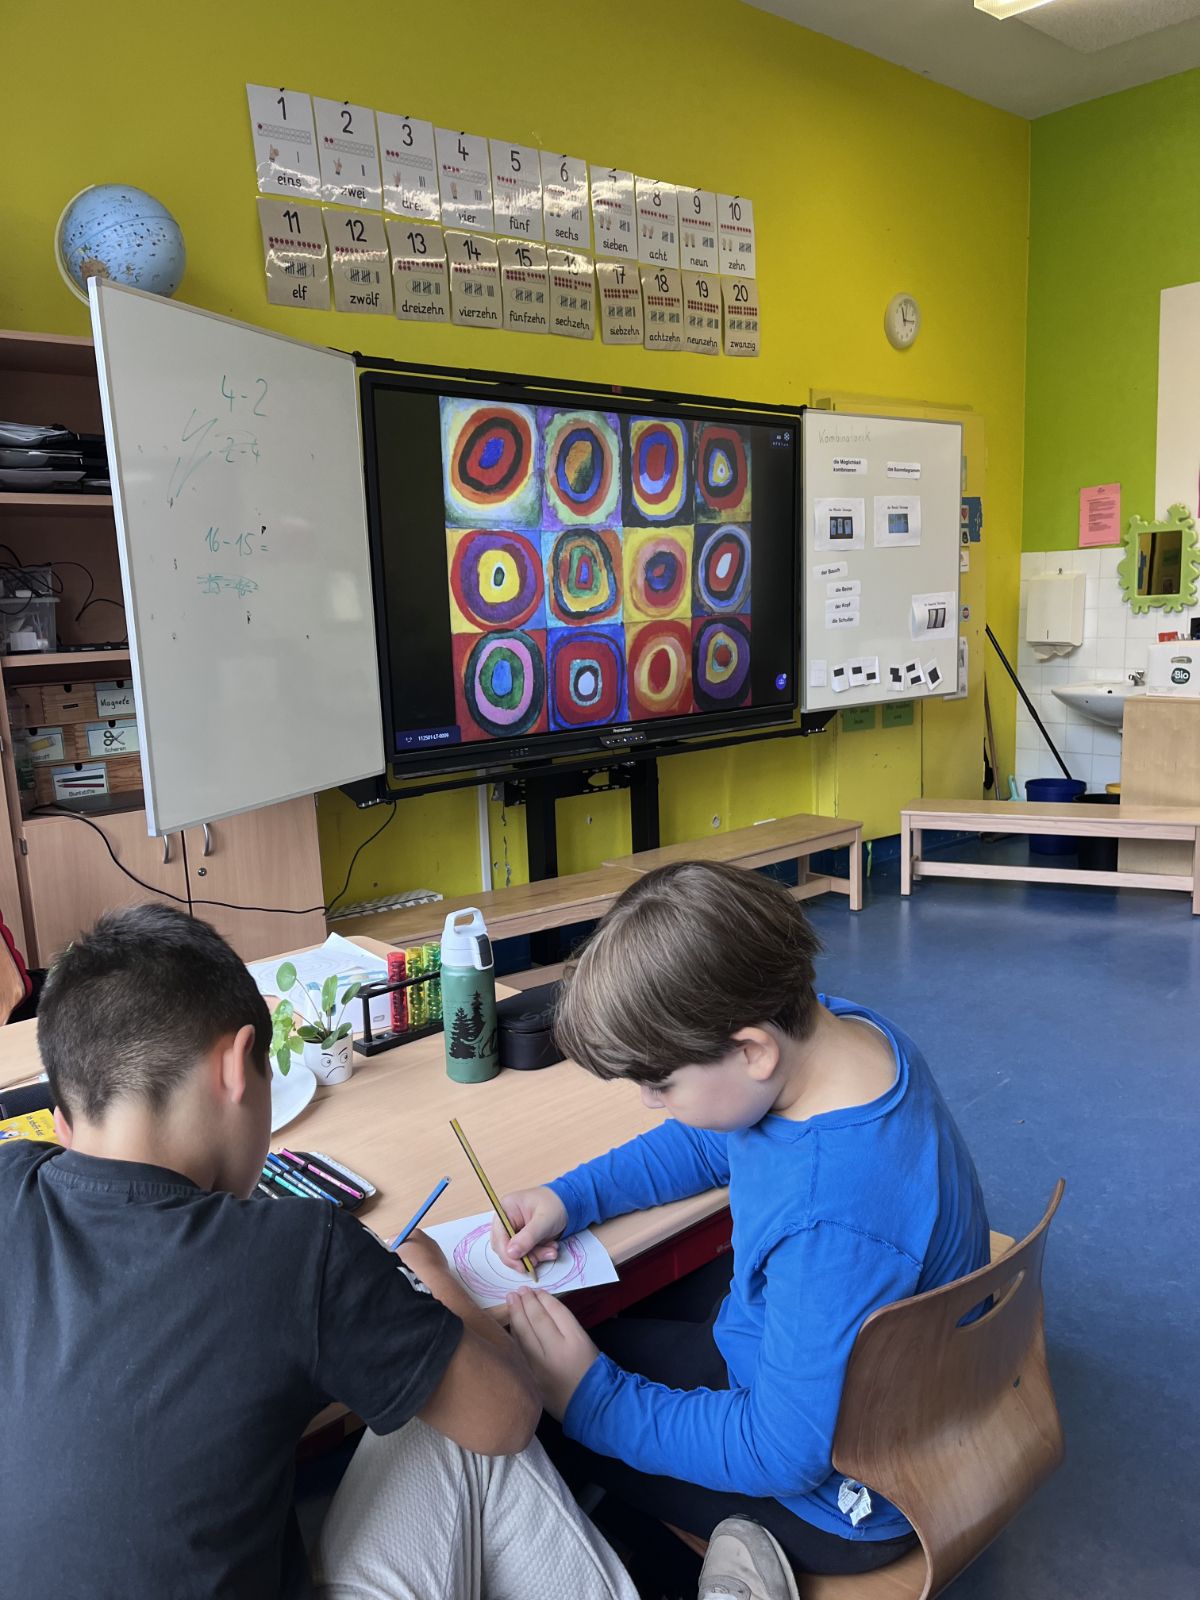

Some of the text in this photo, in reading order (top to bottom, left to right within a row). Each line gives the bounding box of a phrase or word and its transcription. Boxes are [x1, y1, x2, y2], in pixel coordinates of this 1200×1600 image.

[277, 97, 287, 121] 1
[340, 110, 354, 135] 2
[401, 124, 414, 147] 3
[458, 139, 469, 162] 4
[510, 150, 522, 172] 5
[277, 173, 302, 188] eins
[560, 162, 569, 183] 6
[340, 186, 367, 200] zwei
[402, 197, 424, 212] dre
[693, 195, 702, 215] 9
[728, 202, 742, 222] 10
[282, 210, 302, 234] 11
[458, 210, 477, 224] vier
[509, 216, 531, 233] fünf
[345, 219, 368, 242] 12
[555, 226, 579, 241] sechs
[407, 232, 427, 254] 13
[462, 240, 482, 261] 14
[602, 238, 629, 253] sieben
[515, 247, 533, 268] 15
[649, 250, 668, 262] acht
[690, 257, 709, 268] neun
[613, 265, 626, 284] 17
[728, 260, 746, 272] zehn
[654, 274, 669, 293] 18
[695, 280, 709, 298] 19
[292, 284, 308, 301] elf
[349, 291, 380, 307] zwölf
[732, 284, 749, 303] 20
[401, 299, 444, 316] dreizehn
[459, 306, 498, 320] vierzehn
[508, 310, 546, 325] fünfzehn
[555, 316, 590, 331] sechzehn
[609, 324, 640, 336] siebzehn
[649, 331, 681, 344] achtzehn
[686, 336, 718, 348] neunzehn
[729, 339, 756, 352] zwanzig
[101, 697, 130, 709] Magnete
